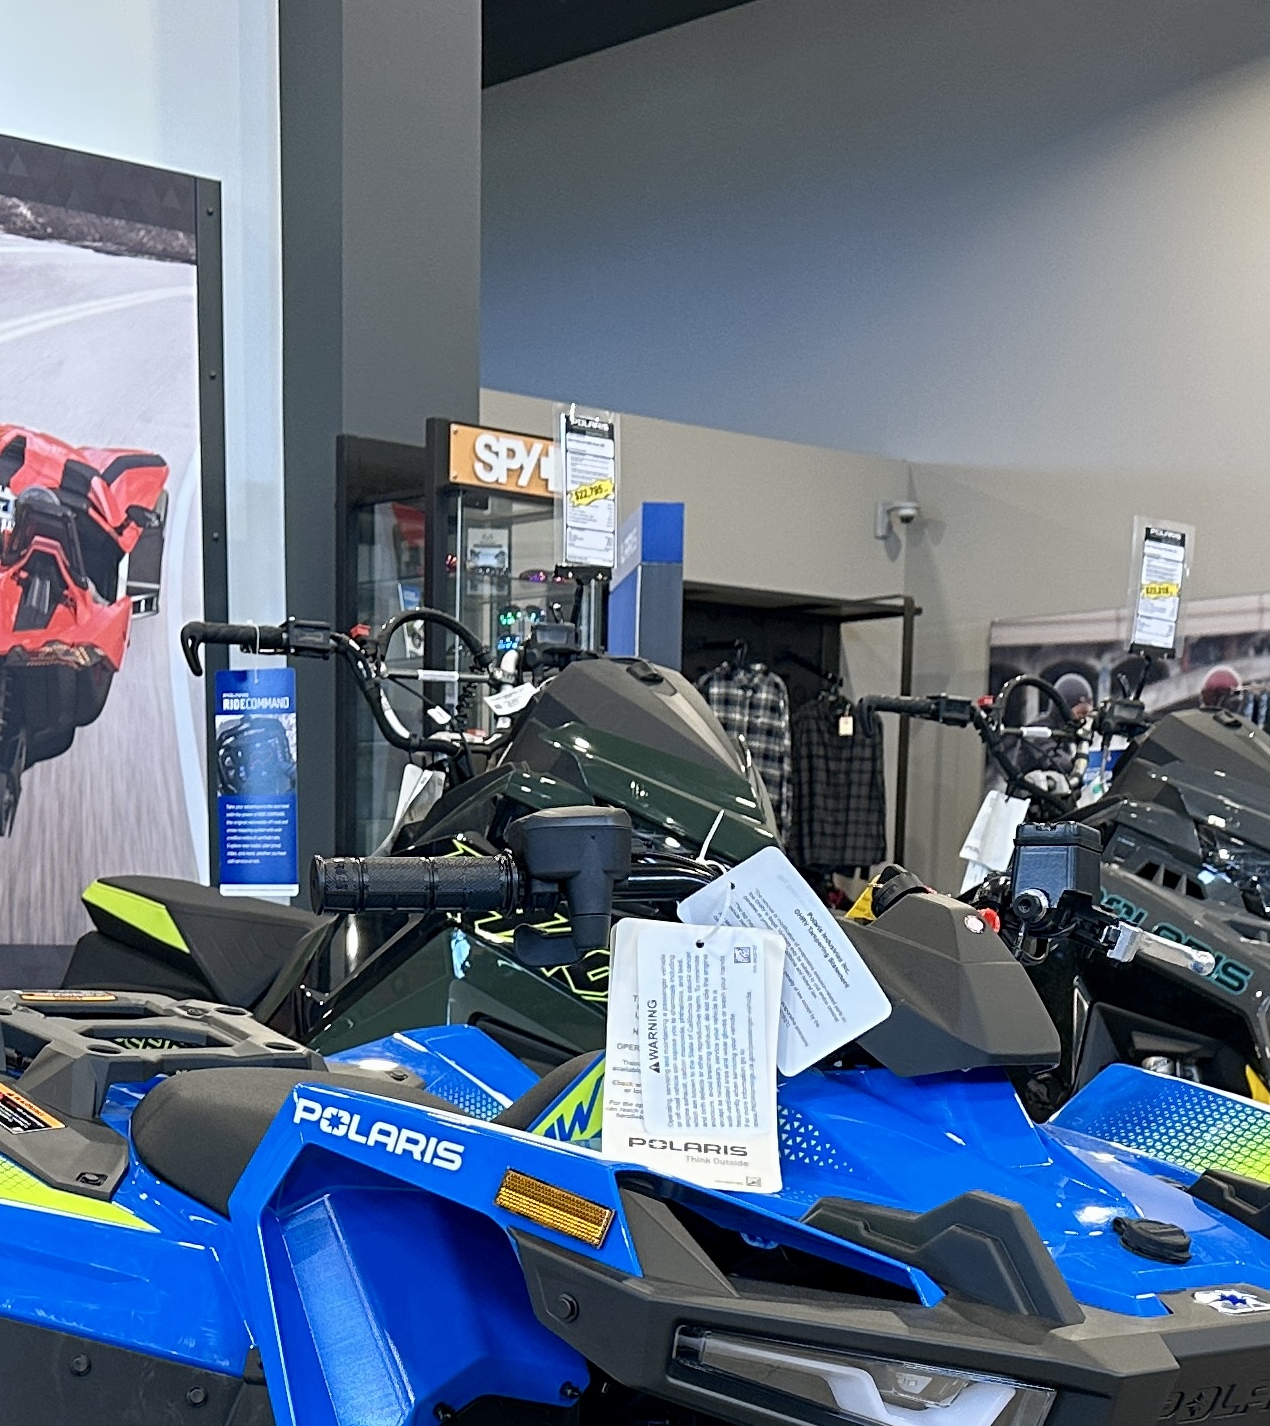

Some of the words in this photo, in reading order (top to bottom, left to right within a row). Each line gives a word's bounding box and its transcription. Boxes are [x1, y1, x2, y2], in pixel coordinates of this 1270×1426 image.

[645, 998, 660, 1060] WARNING
[616, 1042, 640, 1051] OPER
[293, 1097, 465, 1171] POLARIS
[629, 1137, 748, 1157] POLARIS
[685, 1155, 711, 1164] Think
[713, 1157, 749, 1167] Outside
